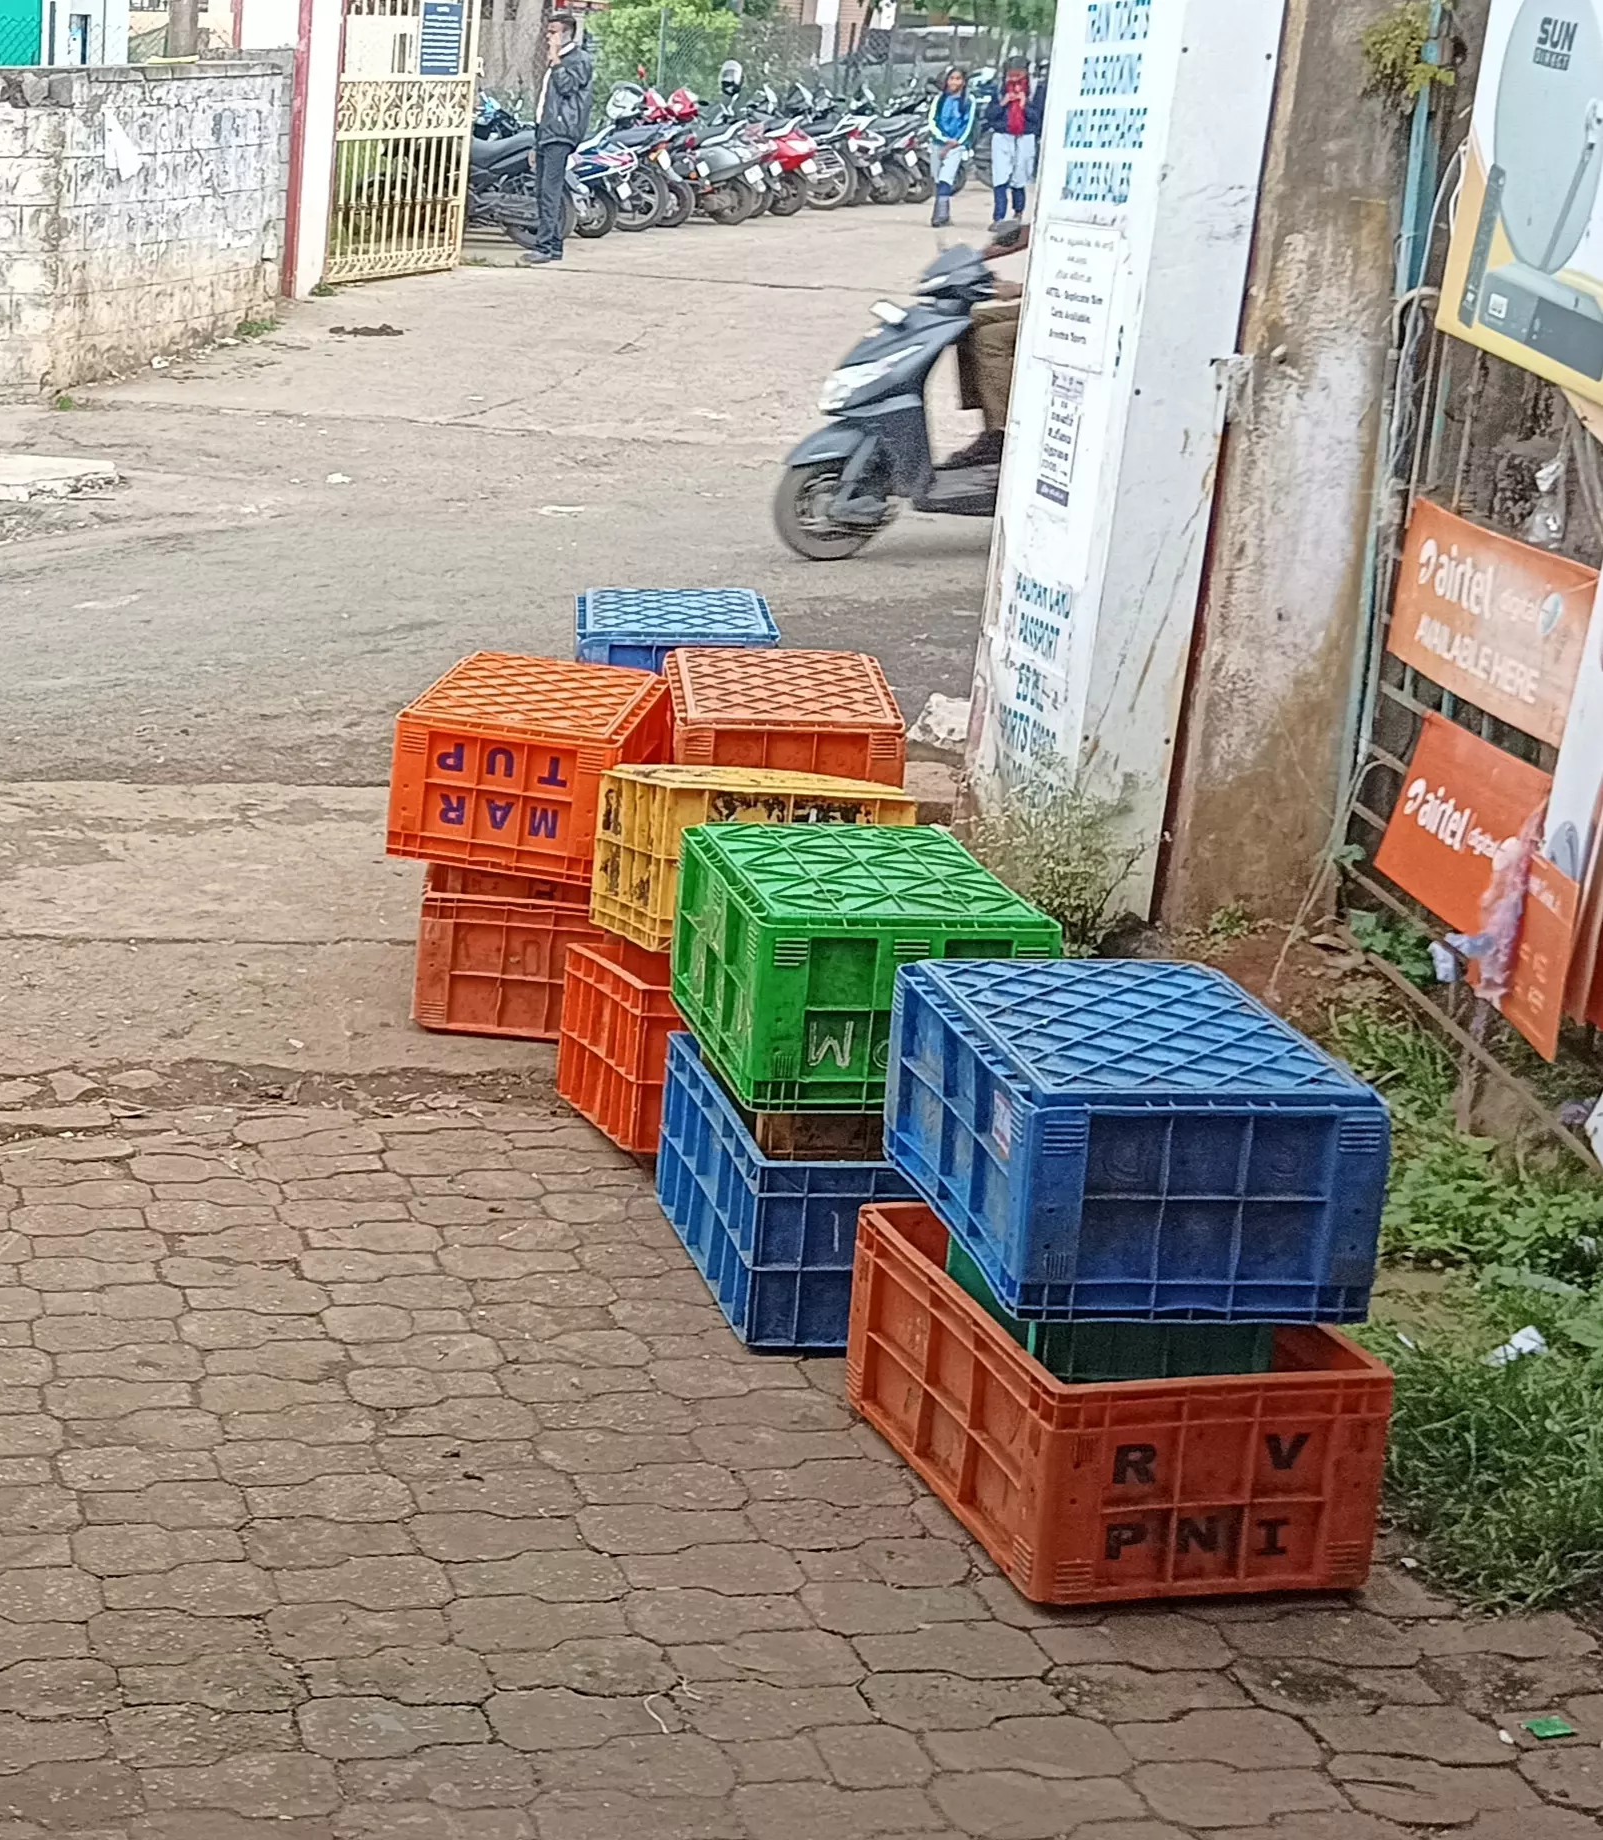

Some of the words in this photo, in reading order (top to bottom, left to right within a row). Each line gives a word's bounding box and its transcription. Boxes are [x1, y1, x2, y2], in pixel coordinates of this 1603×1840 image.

[1534, 48, 1569, 70] DIRECT
[1537, 17, 1578, 52] SUN
[1434, 544, 1494, 620] airtel
[1414, 613, 1493, 679] AVAILABLE
[1489, 651, 1540, 704] HERE
[1418, 786, 1470, 850] airtel
